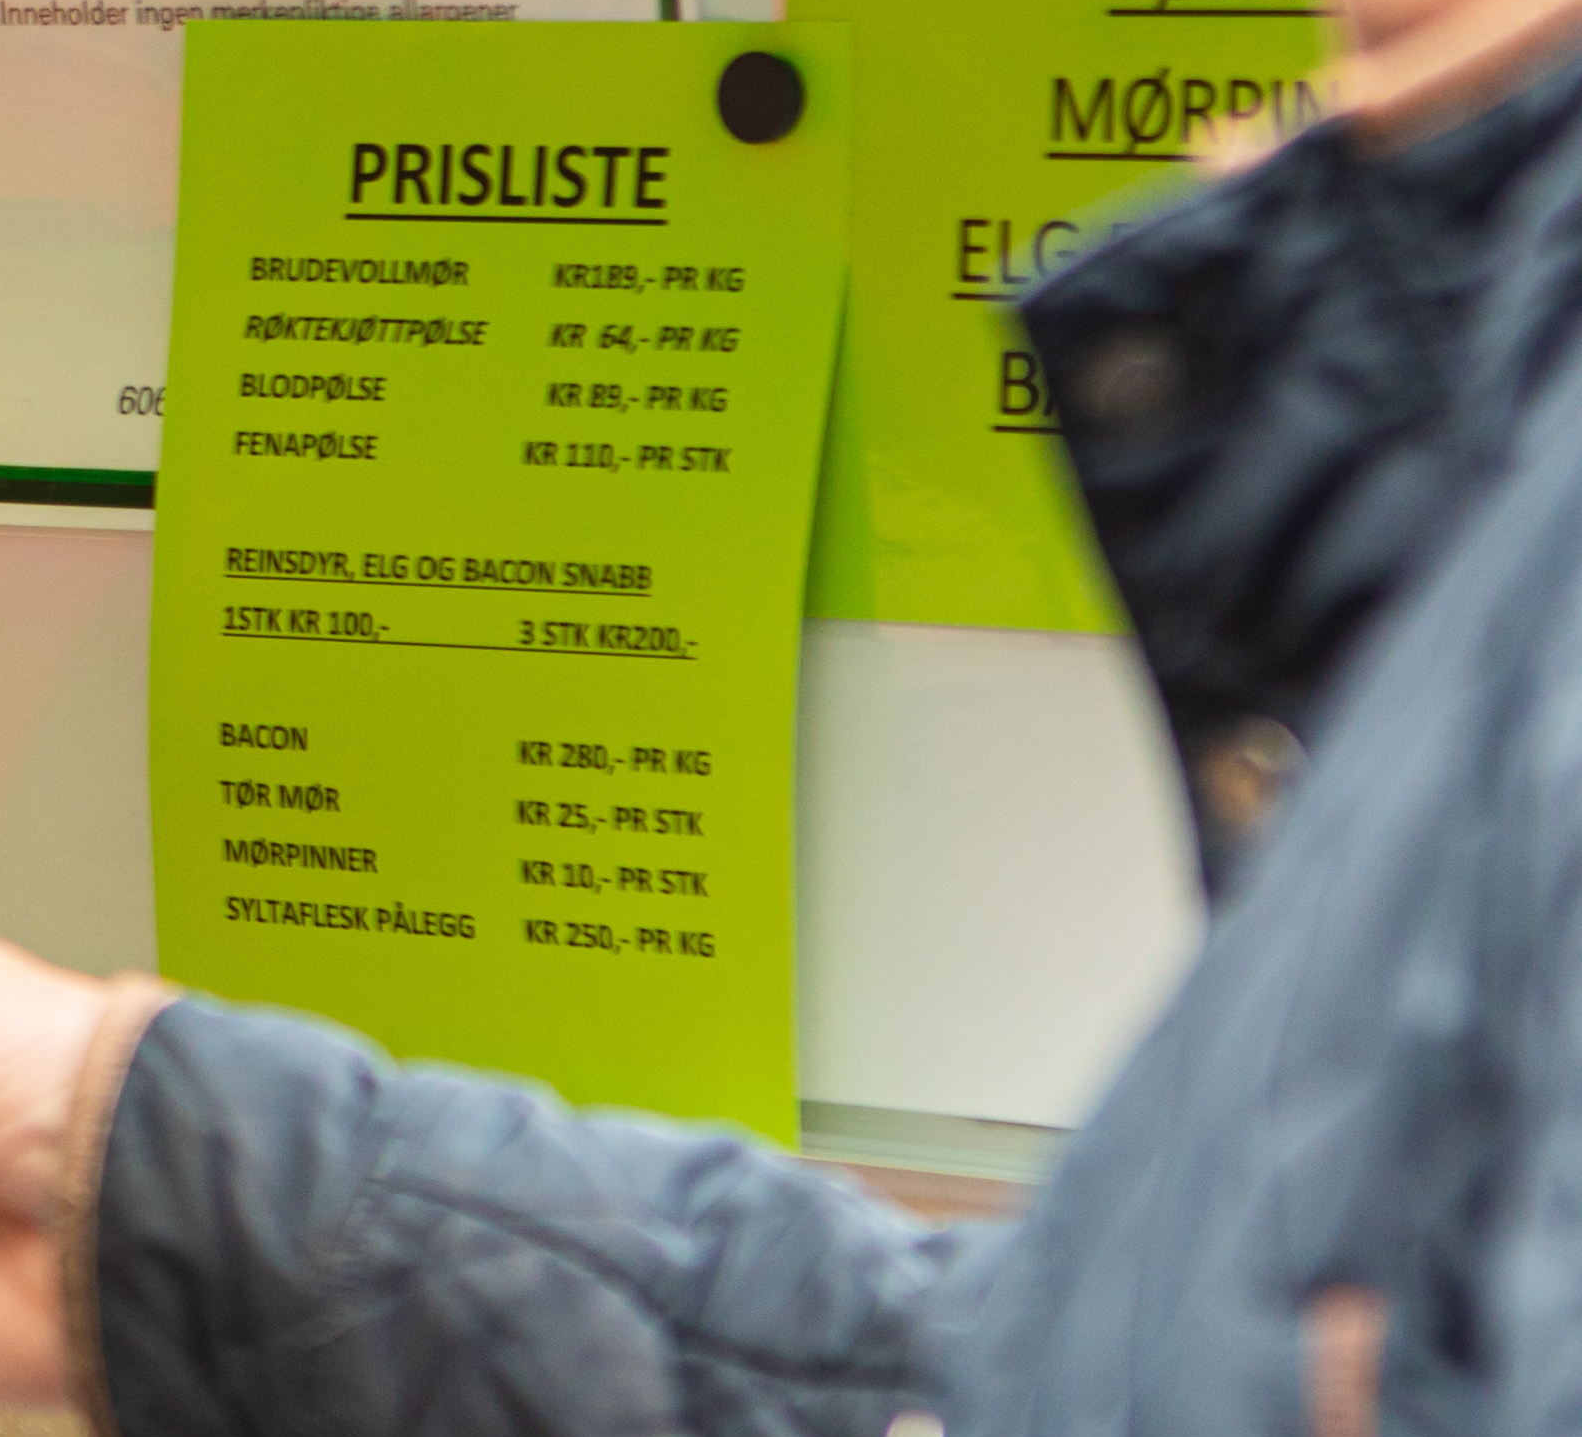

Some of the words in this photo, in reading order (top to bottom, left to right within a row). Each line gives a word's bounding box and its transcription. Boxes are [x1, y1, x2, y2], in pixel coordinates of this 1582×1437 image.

[135, 1, 204, 30] ingen
[350, 141, 671, 210] PRISLISTE
[250, 256, 470, 288] BRUDEVOLLMØR
[554, 263, 656, 295] KR189,-
[662, 266, 700, 291] PR
[705, 267, 746, 293] KG
[243, 314, 490, 347] RØKTEKJØTTPØLSE
[549, 323, 588, 349] KR
[597, 324, 651, 355] 64,-
[656, 325, 694, 352] PR
[700, 327, 742, 353] KG
[240, 372, 387, 405] BLODPØLSE
[546, 382, 582, 408] KR
[588, 383, 640, 414] 89,-
[645, 385, 682, 410] PR
[688, 387, 729, 413] KG
[234, 429, 378, 462] FENAPØLSE
[523, 441, 559, 466] KR
[565, 442, 632, 473] 110,-
[636, 445, 674, 470] PR
[680, 446, 732, 473] STK
[226, 547, 356, 581] REINSDYR,
[363, 553, 409, 580] ELG
[416, 555, 455, 582] OG
[462, 556, 556, 587] BACON
[561, 561, 653, 591] SNABB
[222, 605, 283, 633] 1STK
[289, 608, 322, 634] KR
[328, 610, 391, 642] 100,-
[518, 619, 536, 646] 3
[540, 621, 590, 649] STK
[597, 624, 699, 657] KR200,-
[219, 723, 309, 752] BACON
[519, 740, 554, 767] KR
[559, 742, 627, 773] 280,-
[630, 746, 668, 773] PR
[674, 749, 712, 776] KG
[220, 779, 273, 810] TØR
[278, 782, 341, 814] MØR
[516, 800, 552, 827] KR
[556, 802, 608, 832] 25,-
[613, 805, 649, 833] PR
[653, 808, 704, 837] STK
[223, 838, 379, 875] MØRPINNER
[520, 860, 555, 886] KR
[561, 862, 614, 893] 10,-
[618, 866, 654, 893] PR
[659, 869, 709, 898] STK
[224, 896, 370, 932] SYLTAFLESK
[375, 901, 477, 939] PÅLEGG
[524, 918, 560, 946] KR
[564, 921, 631, 954] 250,-
[637, 925, 673, 954] PR
[677, 930, 716, 959] KG
